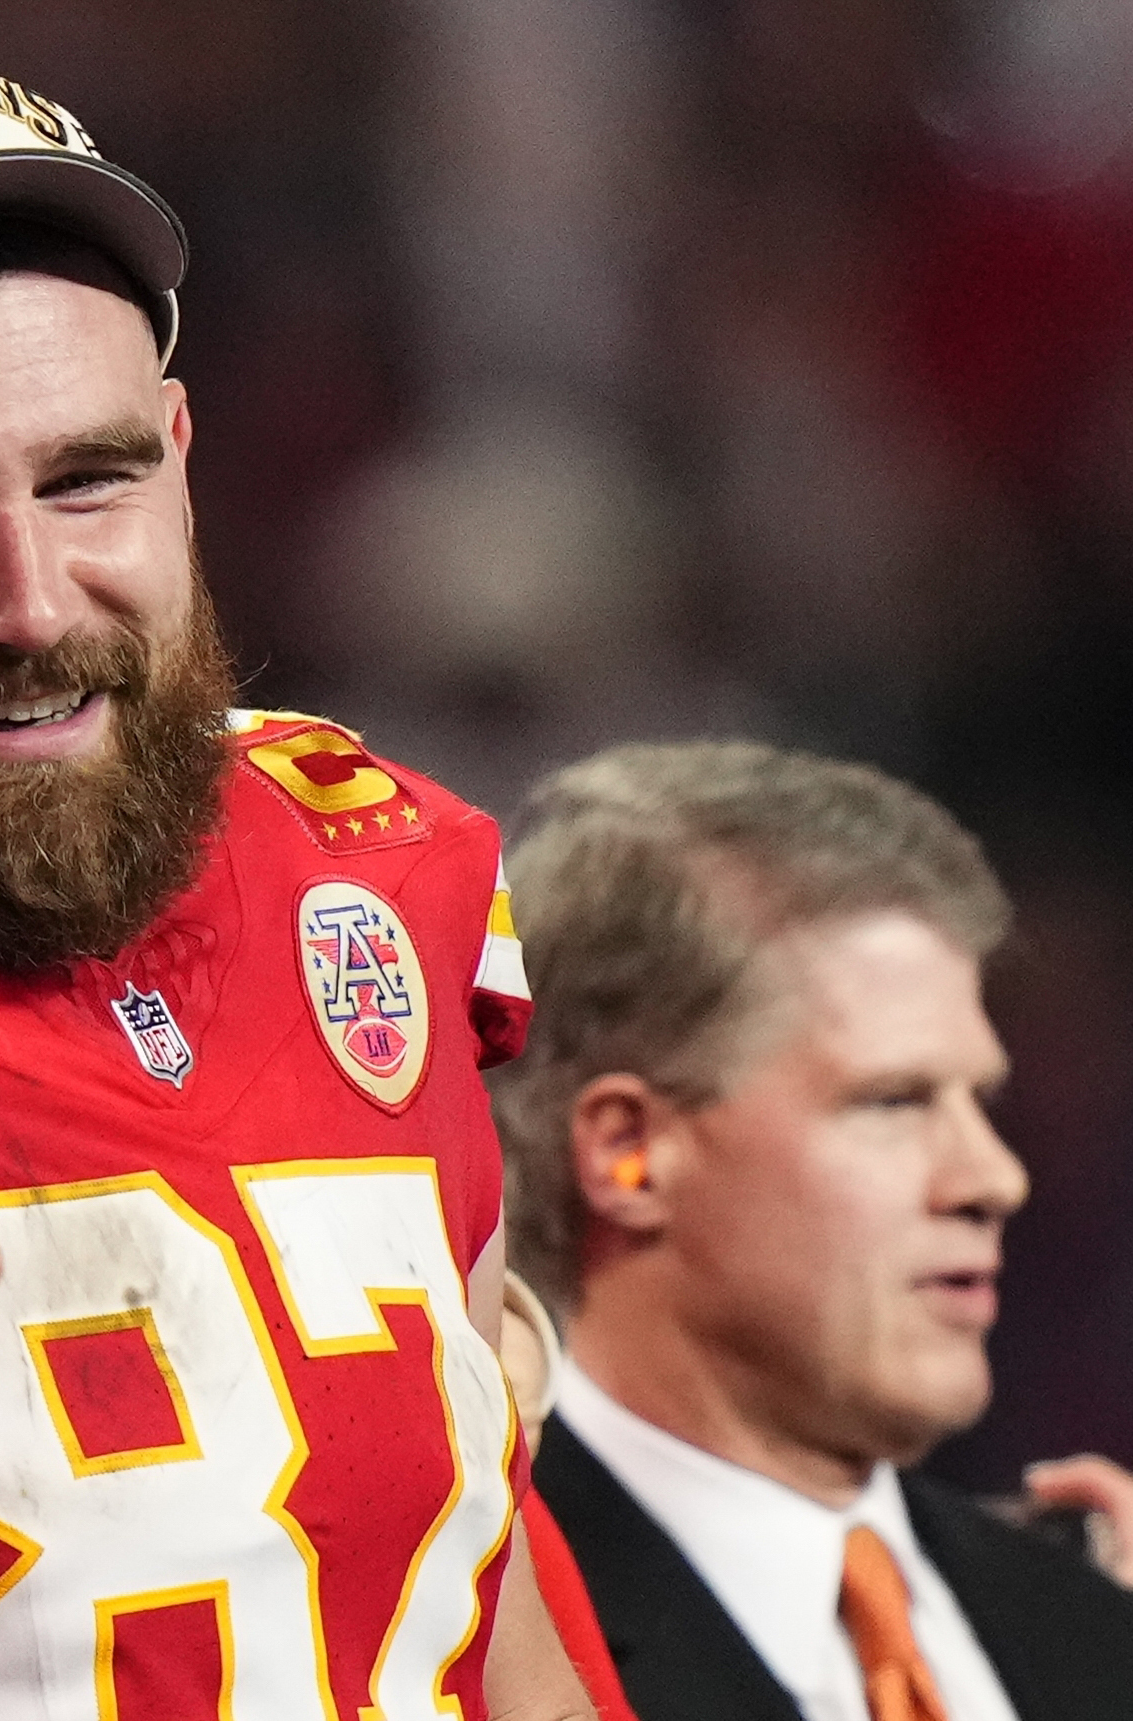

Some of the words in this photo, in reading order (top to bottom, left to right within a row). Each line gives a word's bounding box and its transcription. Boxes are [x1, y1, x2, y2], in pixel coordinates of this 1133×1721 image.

[247, 730, 397, 813] C
[314, 904, 412, 1022] A
[138, 1027, 185, 1069] NFL
